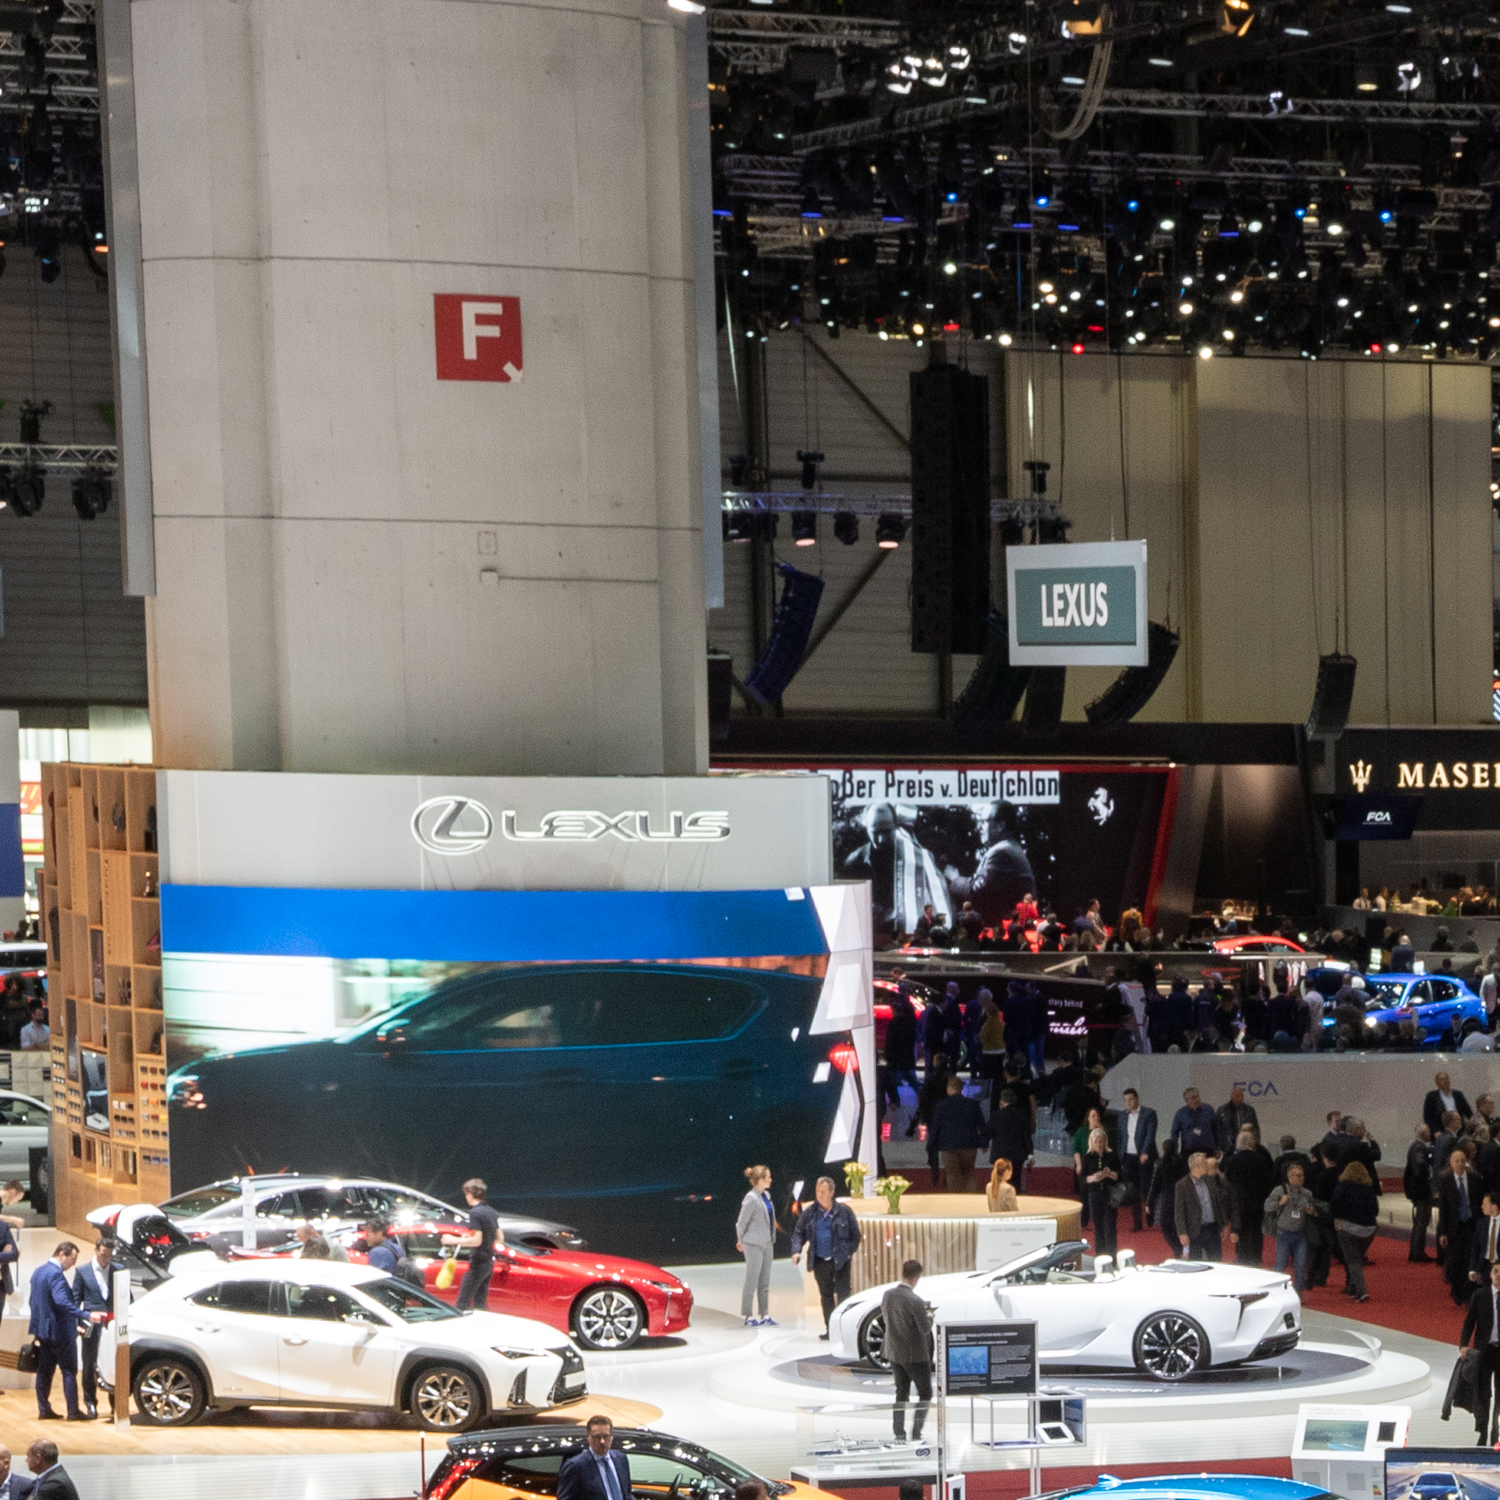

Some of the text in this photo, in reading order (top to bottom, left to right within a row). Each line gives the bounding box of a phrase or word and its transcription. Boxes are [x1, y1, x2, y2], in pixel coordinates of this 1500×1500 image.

[461, 302, 504, 361] F
[1041, 582, 1109, 628] LEXUS
[885, 770, 935, 798] Preis
[502, 809, 732, 844] LEXUS
[1366, 811, 1391, 823] FCA
